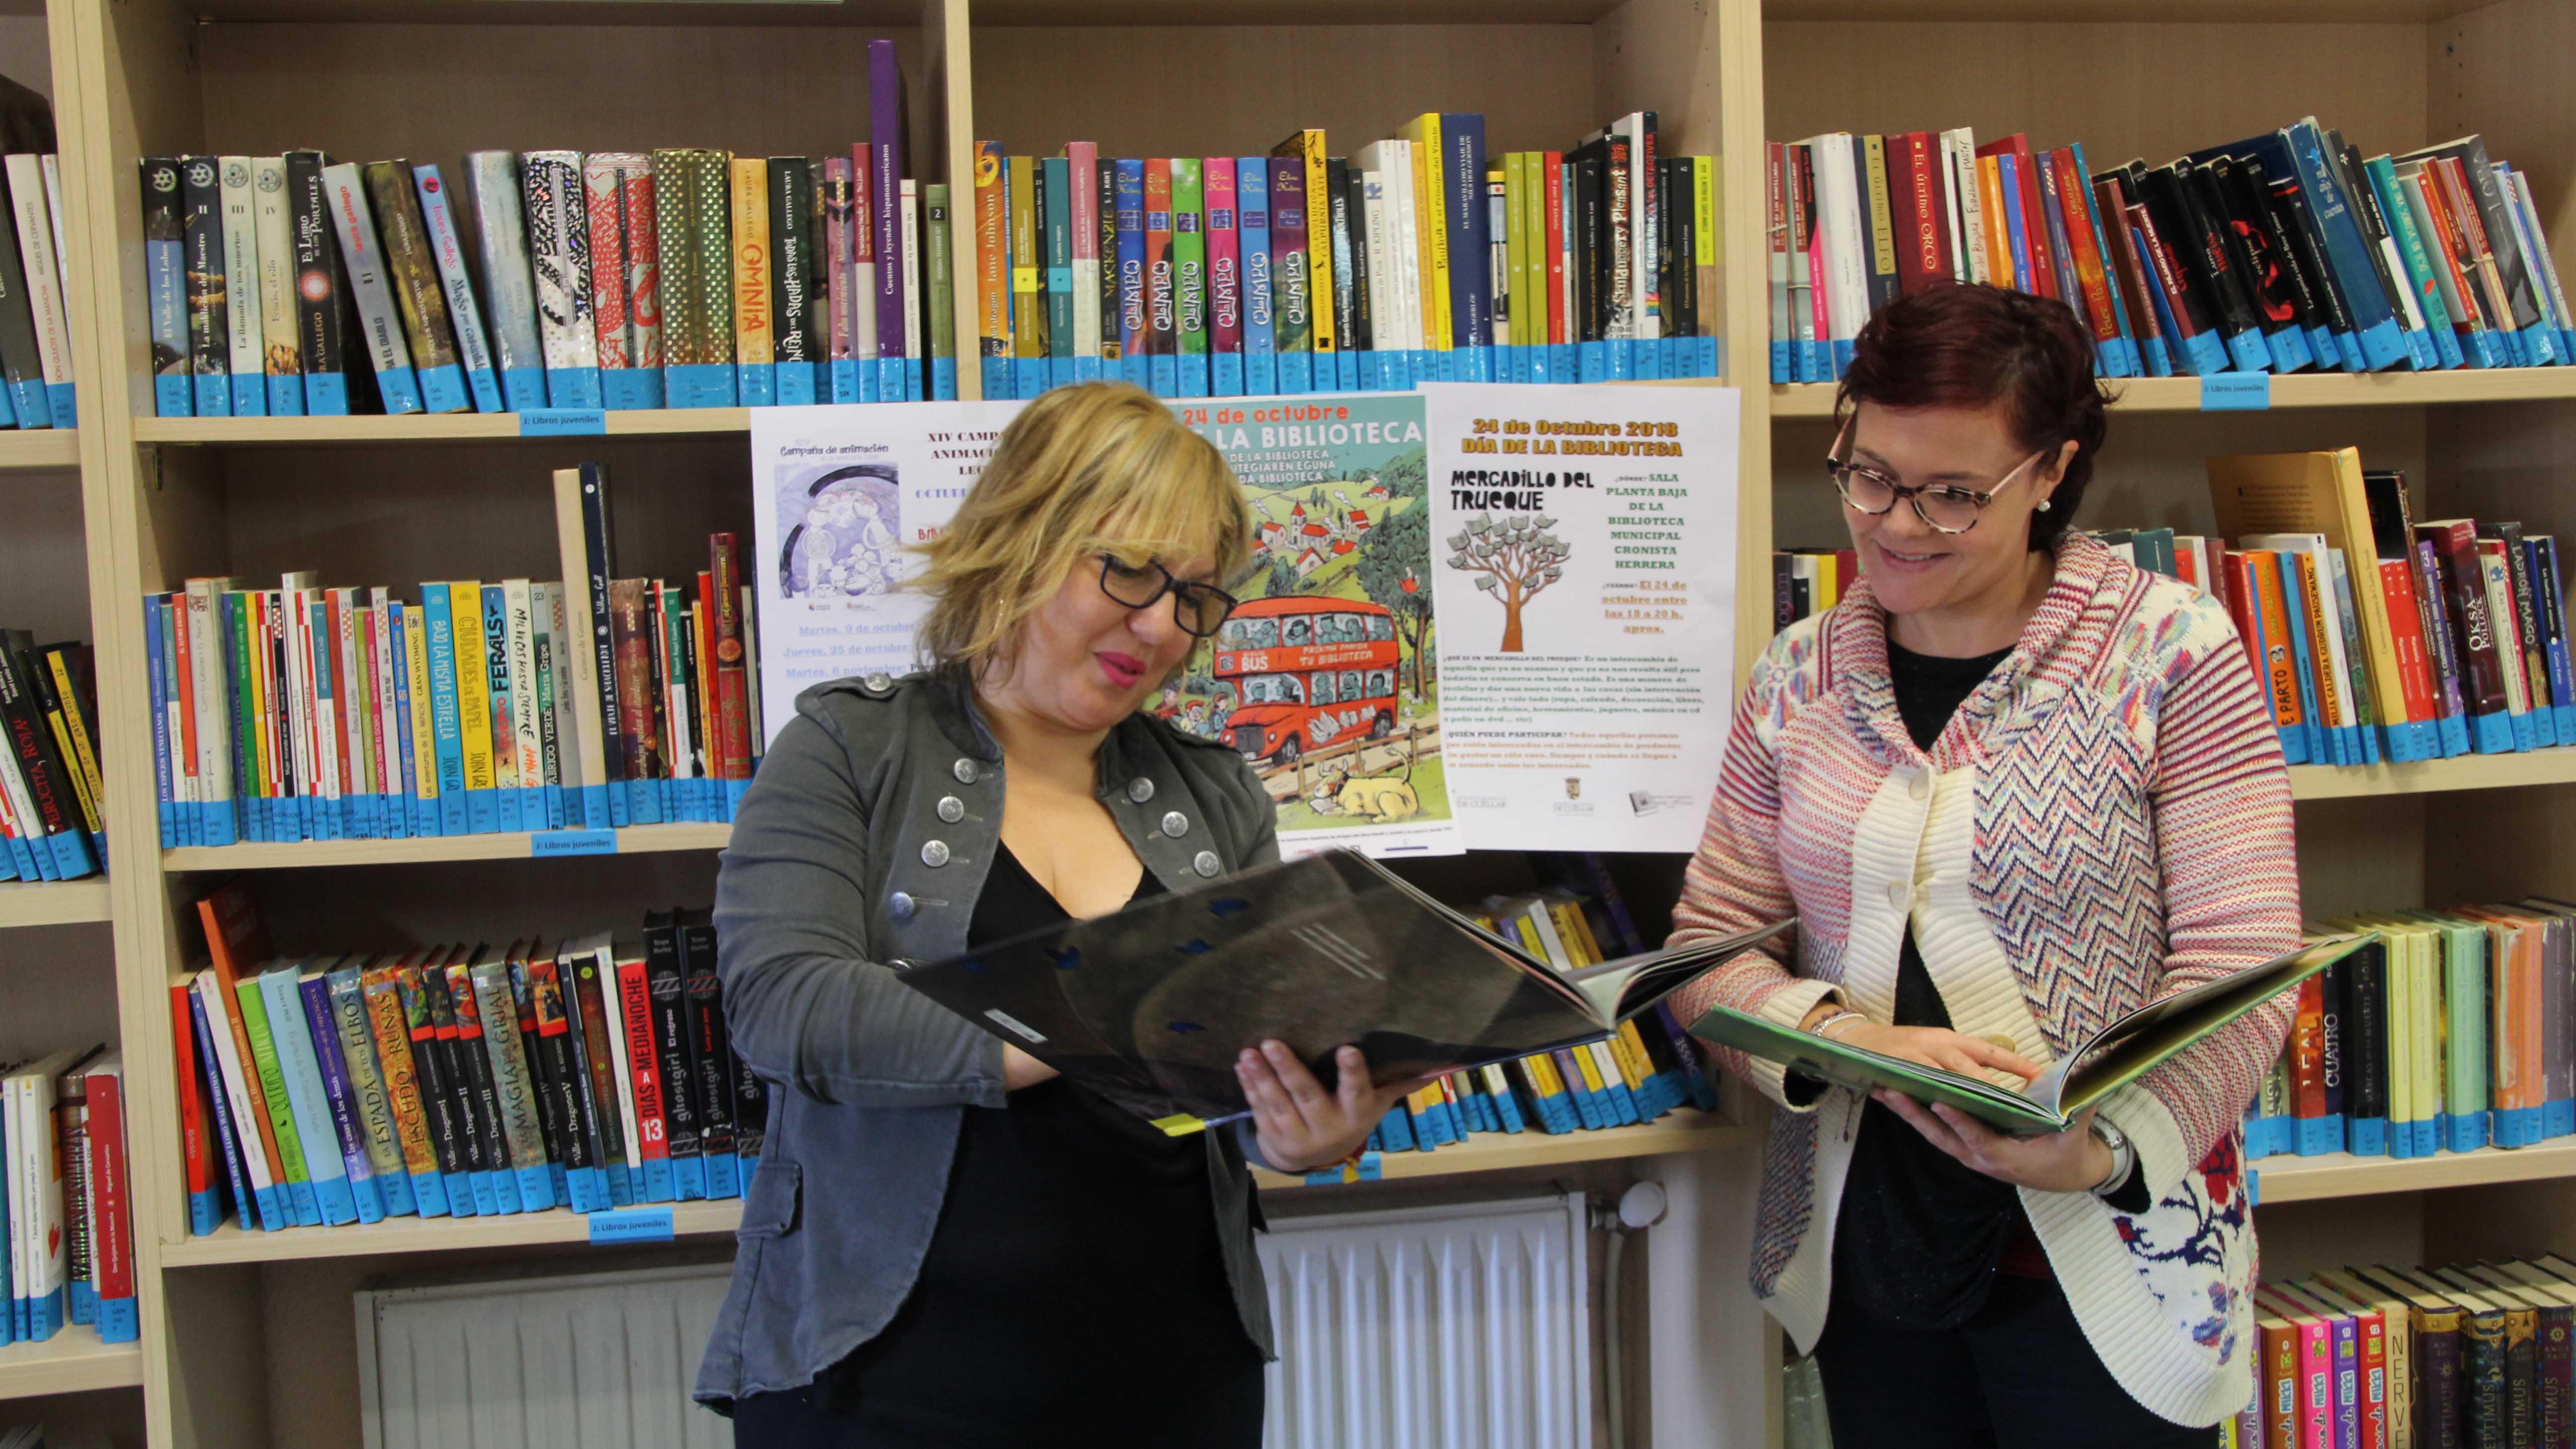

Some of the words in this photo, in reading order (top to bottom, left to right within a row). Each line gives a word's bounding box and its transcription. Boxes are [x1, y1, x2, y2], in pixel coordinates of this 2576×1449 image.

[881, 144, 893, 218] hispanoamericanos
[1610, 168, 1627, 222] Pleasant
[883, 219, 894, 253] leyendas
[1920, 222, 1937, 270] ORCO
[739, 243, 766, 333] OMNIA
[884, 262, 894, 295] Cuentos
[532, 415, 558, 424] Libros
[560, 414, 600, 425] juveniles
[1182, 408, 1208, 426] 24
[1217, 408, 1244, 424] de
[1253, 404, 1349, 422] octubre
[928, 433, 952, 443] XIV
[958, 432, 998, 441] CAMP
[1215, 427, 1250, 450] LA
[1261, 421, 1423, 448] BIBLIOTECA
[1473, 419, 1498, 434] 24
[1504, 419, 1530, 434] de
[1536, 419, 1620, 436] Octubre
[1626, 422, 1678, 437] 2018
[780, 445, 823, 457] Campaña
[826, 446, 837, 454] de
[840, 444, 888, 454] animación
[931, 449, 993, 459] ANIMACI
[1230, 453, 1244, 463] DE
[1247, 452, 1261, 462] LA
[1265, 450, 1330, 461] BIBLIOTECA
[1462, 436, 1498, 454] DÍA
[1503, 439, 1527, 454] DE
[1533, 439, 1556, 455] LA
[1562, 440, 1683, 457] BIBLIOTECA
[1230, 462, 1293, 474] UTEGIAREN
[1296, 461, 1336, 471] EGUNA
[1260, 472, 1324, 483] BIBLIOTECA
[1649, 474, 1678, 482] SALA
[1606, 487, 1655, 496] PLANTA
[1658, 488, 1688, 498] BAJA
[1608, 517, 1685, 526] BIBLIOTECA
[1610, 532, 1682, 540] MUNICIPAL
[1614, 546, 1677, 555] CRONISTA
[1640, 581, 1651, 589] El
[1655, 581, 1669, 589] 24
[1672, 581, 1687, 590] de
[2306, 566, 2323, 619] PAUSEWANG
[1602, 595, 1650, 604] octubre
[1654, 596, 1687, 605] entre
[1605, 609, 1623, 619] las
[1654, 610, 1669, 619] 20
[2467, 599, 2483, 651] OKSA
[2476, 596, 2491, 649] POLLOCK
[431, 619, 448, 644] BAJO
[856, 624, 867, 633] de
[1623, 625, 1664, 636] aprox.
[2315, 619, 2329, 655] GUDRUN
[432, 644, 448, 658] LA
[458, 615, 481, 685] CIUDADES
[486, 617, 509, 693] FERALS
[538, 643, 551, 672] Gripe
[849, 645, 860, 653] de
[1318, 650, 1373, 664] BIBLIOTECA
[1241, 656, 1268, 671] BUS
[433, 659, 452, 693] MISMA
[2321, 656, 2335, 698] CALDERA
[2274, 669, 2292, 713] PARTO
[436, 694, 456, 740] ESTRELLA
[464, 696, 483, 735] PAPEL
[496, 696, 510, 748] CUERVO
[546, 744, 558, 784] ABRIGO
[572, 839, 611, 849] juveniles
[340, 991, 366, 1048] ELBOS
[377, 991, 402, 1055] RUNAS
[628, 976, 653, 1071] MEDIANOCHE
[2323, 1013, 2339, 1088] CUATRO
[561, 1080, 571, 1091] V
[644, 1072, 649, 1083] A
[664, 1051, 693, 1123] ghostgirl
[363, 1076, 391, 1146] ESPADA
[396, 1067, 423, 1145] ESCUDO
[562, 1089, 579, 1132] Dragones
[644, 1119, 663, 1141] 13
[601, 1222, 627, 1232] Libros
[629, 1218, 667, 1231] juveniles
[2342, 1327, 2351, 1338] 11
[2370, 1324, 2380, 1335] 12
[2483, 1384, 2496, 1449] EPTIMUS
